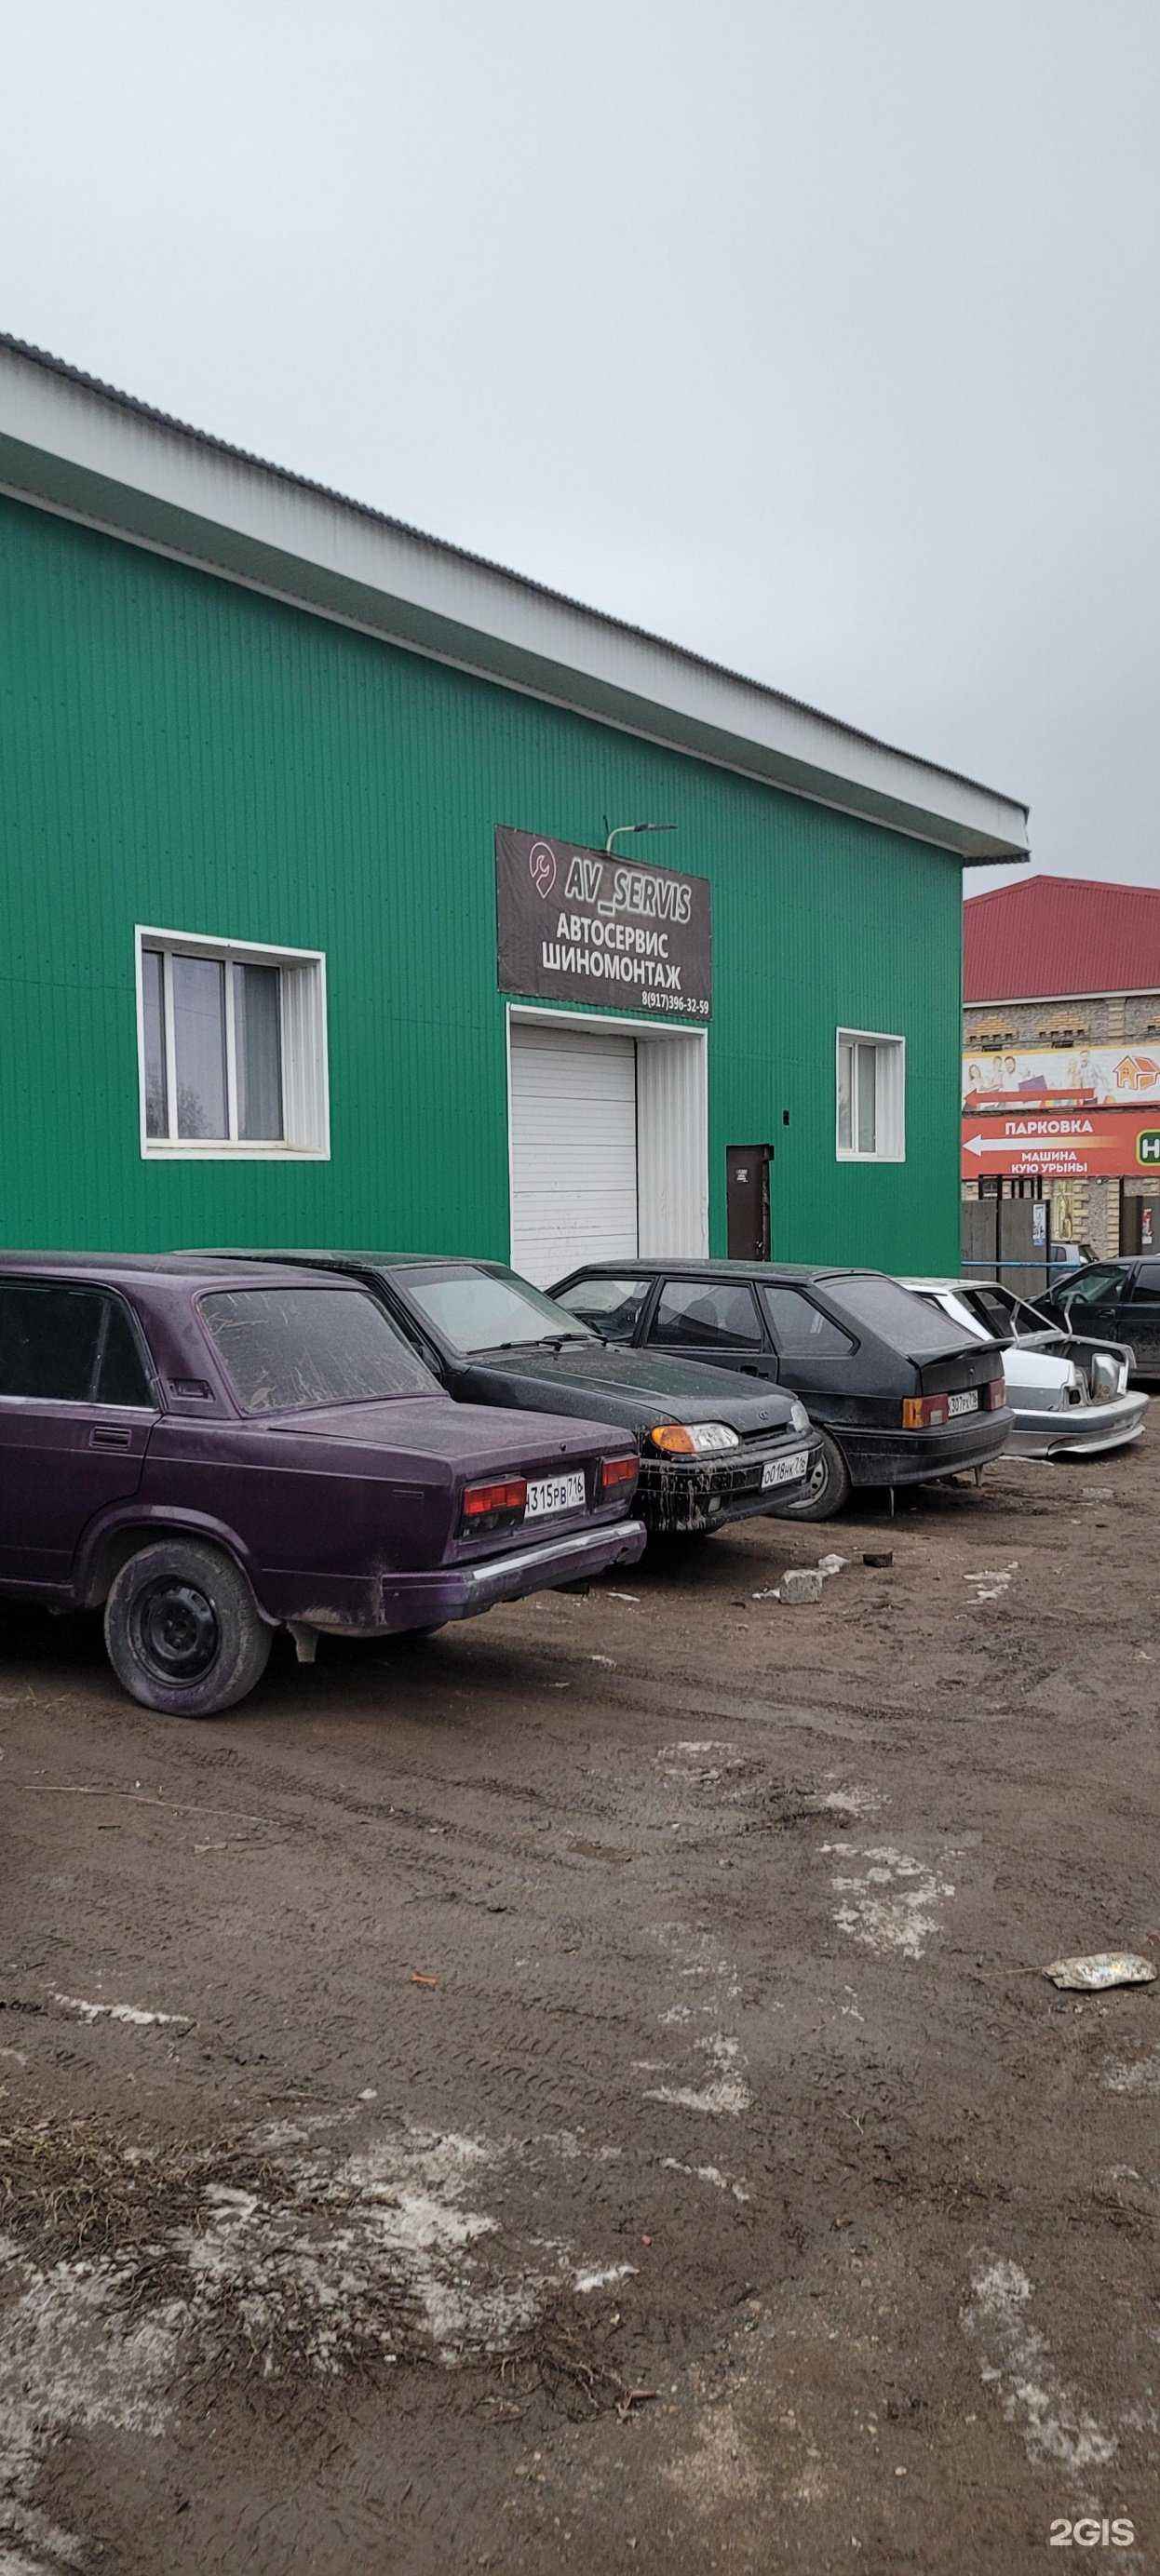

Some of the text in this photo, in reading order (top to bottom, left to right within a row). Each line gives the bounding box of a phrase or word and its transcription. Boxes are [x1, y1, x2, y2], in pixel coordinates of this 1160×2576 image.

[565, 857, 692, 923] AV_SERVIS
[557, 913, 668, 959] АВТОСЕРВИС
[542, 942, 681, 990] ШИНОМОНТАЖ
[641, 990, 709, 1014] 8(917)396-32-59
[1005, 1120, 1094, 1135] ПАРКОВКА
[1021, 1151, 1077, 1162] МАШИНА
[1011, 1163, 1039, 1174] КУЮ
[569, 1476, 583, 1496] 716
